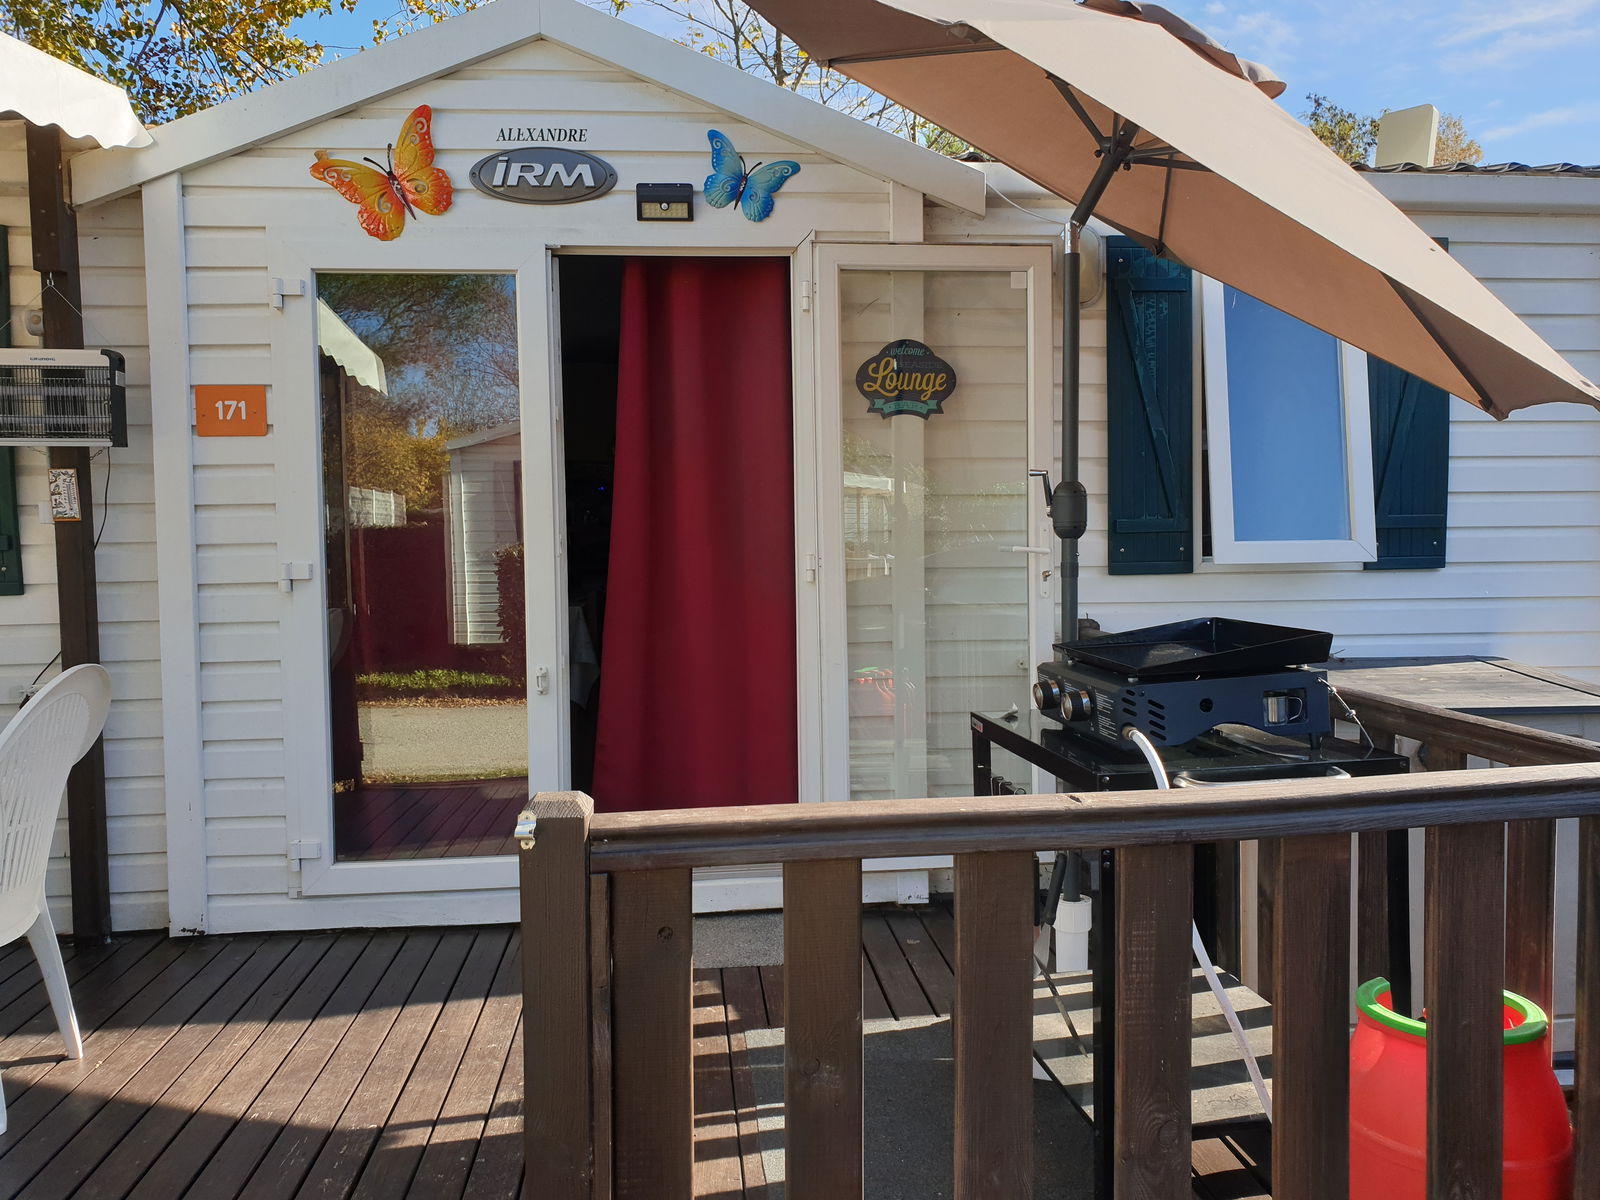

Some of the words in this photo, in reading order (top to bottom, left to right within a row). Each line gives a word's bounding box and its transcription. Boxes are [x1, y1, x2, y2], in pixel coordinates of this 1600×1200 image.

[890, 344, 926, 355] welcome
[863, 357, 947, 401] Lounge
[215, 400, 247, 420] 171
